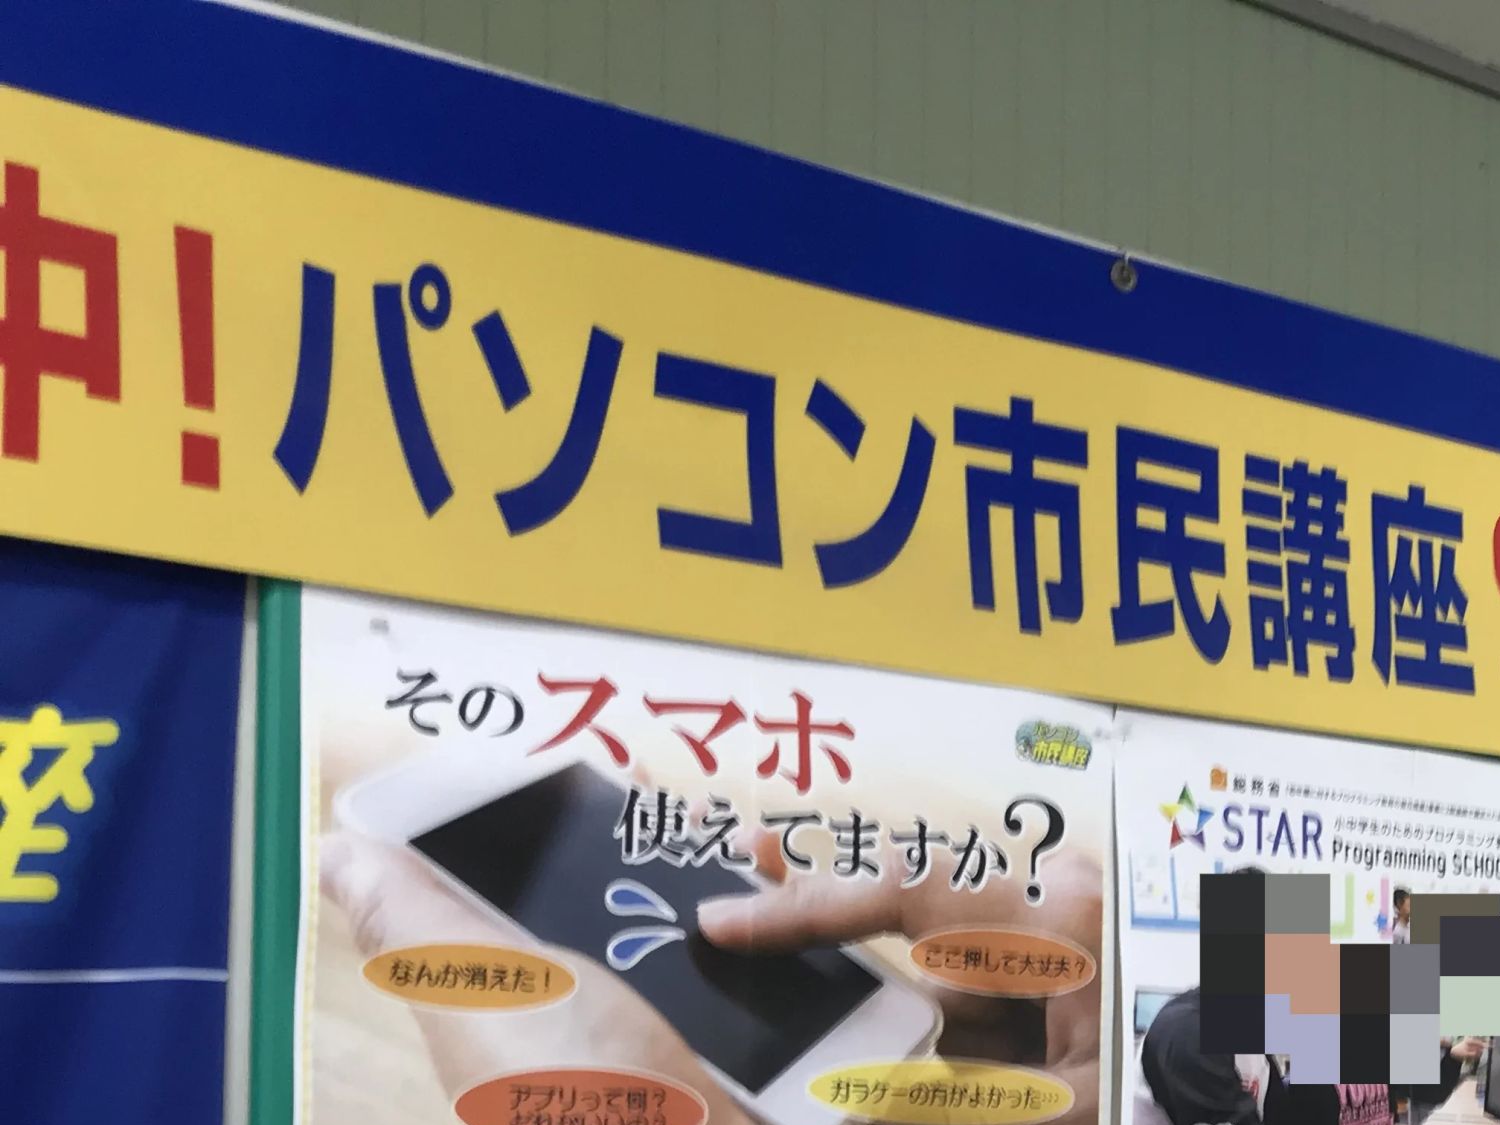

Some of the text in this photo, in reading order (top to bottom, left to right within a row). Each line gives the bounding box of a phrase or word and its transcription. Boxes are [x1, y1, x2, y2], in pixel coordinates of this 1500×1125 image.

[273, 260, 1476, 697] パソコン市民講座
[613, 786, 1066, 903] 使えてますか?
[1222, 801, 1324, 862] STAR
[1331, 835, 1448, 879] Programming
